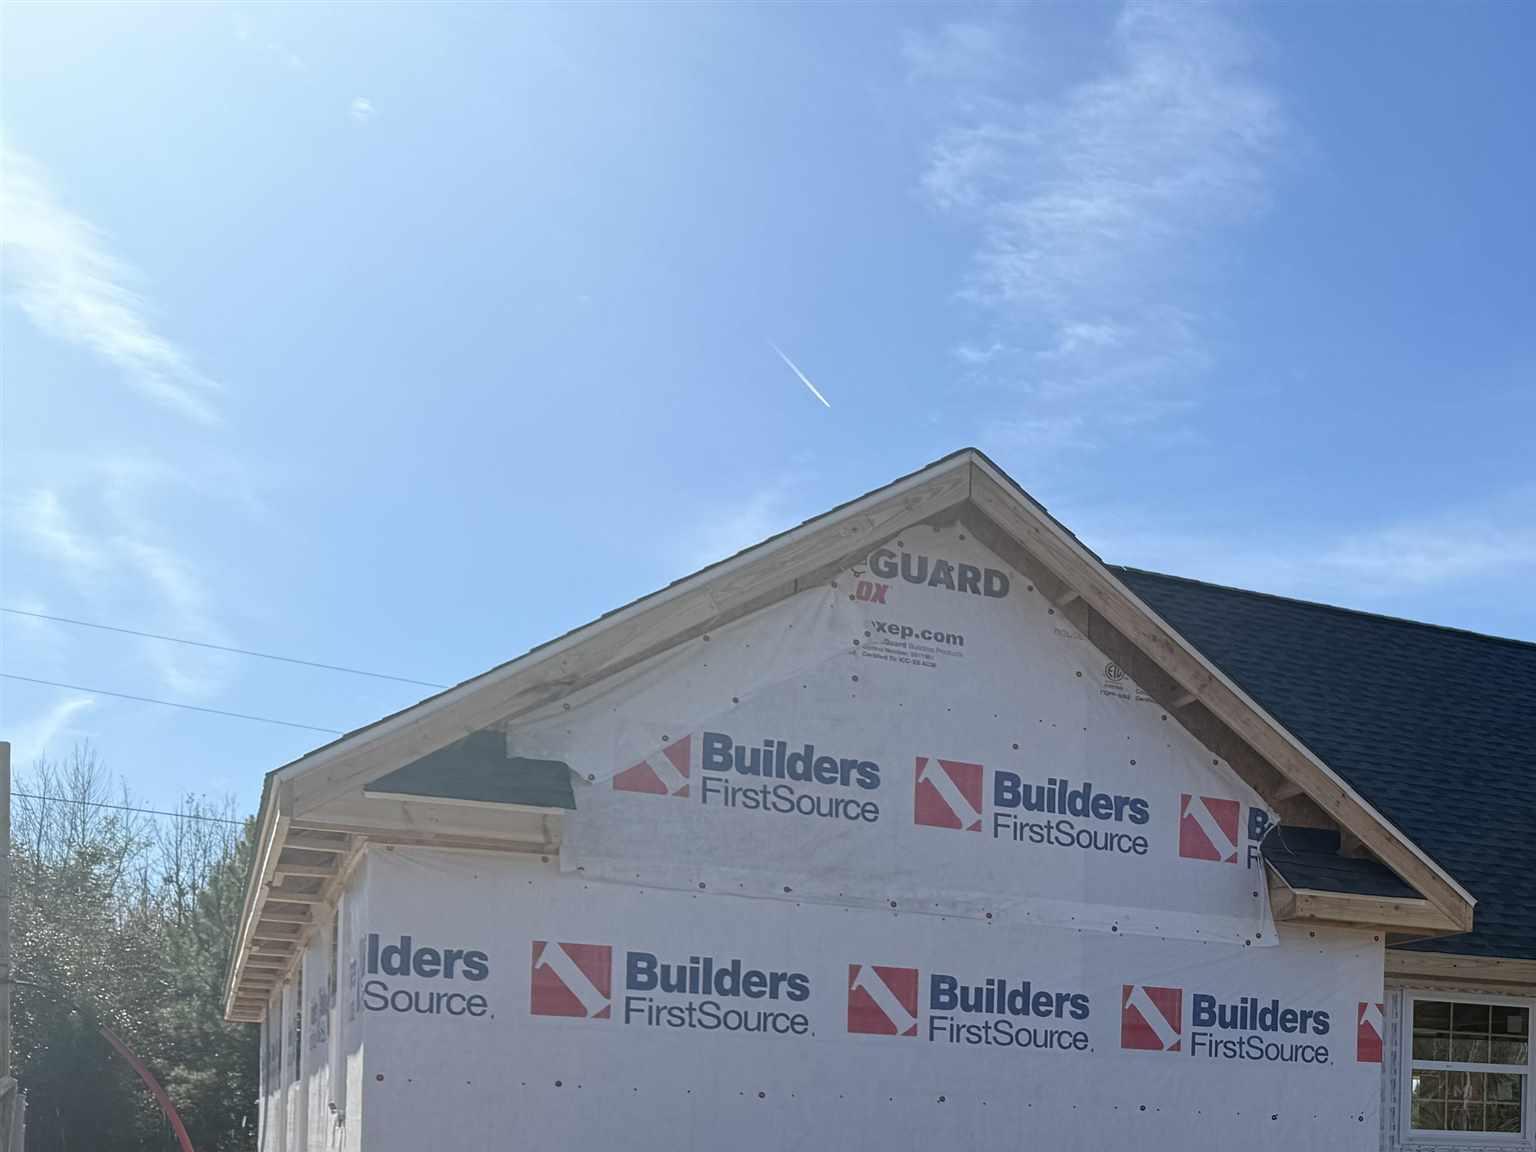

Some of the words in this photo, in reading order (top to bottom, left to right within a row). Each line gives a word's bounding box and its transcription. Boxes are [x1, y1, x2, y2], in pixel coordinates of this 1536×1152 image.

[856, 581, 889, 604] OX
[702, 731, 881, 790] Builders
[701, 776, 880, 823] FirstSource
[993, 770, 1150, 825] Builders
[993, 813, 1148, 855] FirstSource
[626, 951, 810, 1001] Builders
[929, 973, 1090, 1020] Builders
[1192, 993, 1329, 1035] Builders
